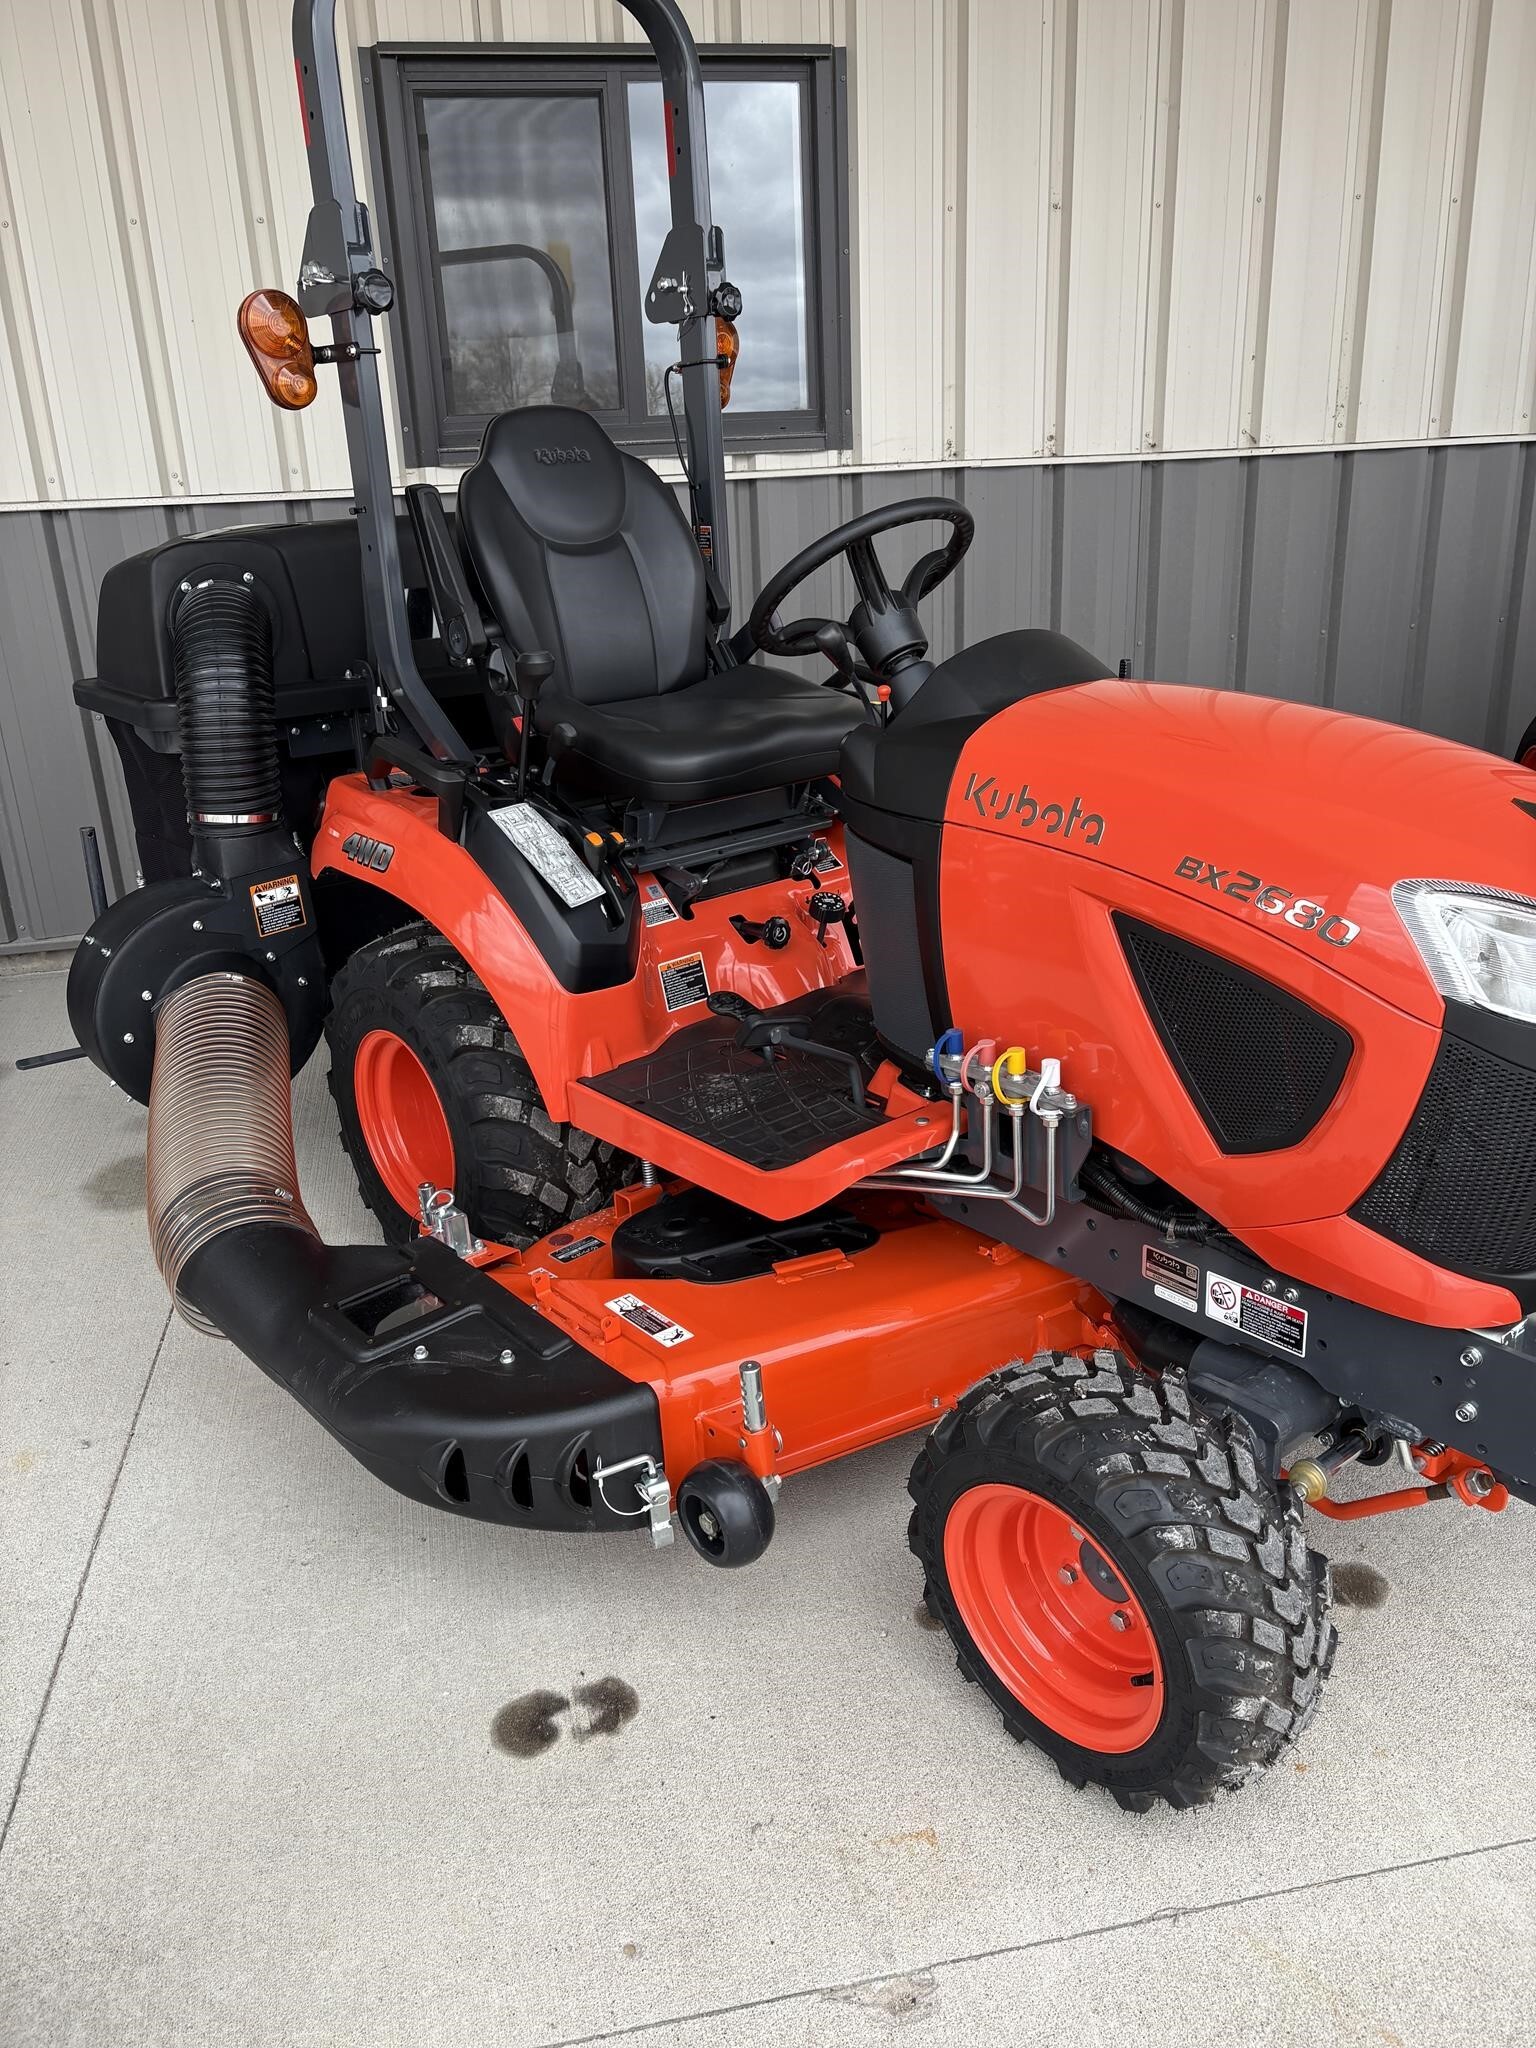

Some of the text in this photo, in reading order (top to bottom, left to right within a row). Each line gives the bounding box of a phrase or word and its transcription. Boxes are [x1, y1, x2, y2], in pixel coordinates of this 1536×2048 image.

[534, 446, 592, 465] Kubota
[964, 772, 1106, 846] Kubota
[342, 832, 395, 873] 4WD
[261, 876, 295, 891] WARNING
[1174, 855, 1361, 948] BX2680
[1152, 1251, 1181, 1270] Kubota
[1254, 1293, 1289, 1314] DANGER
